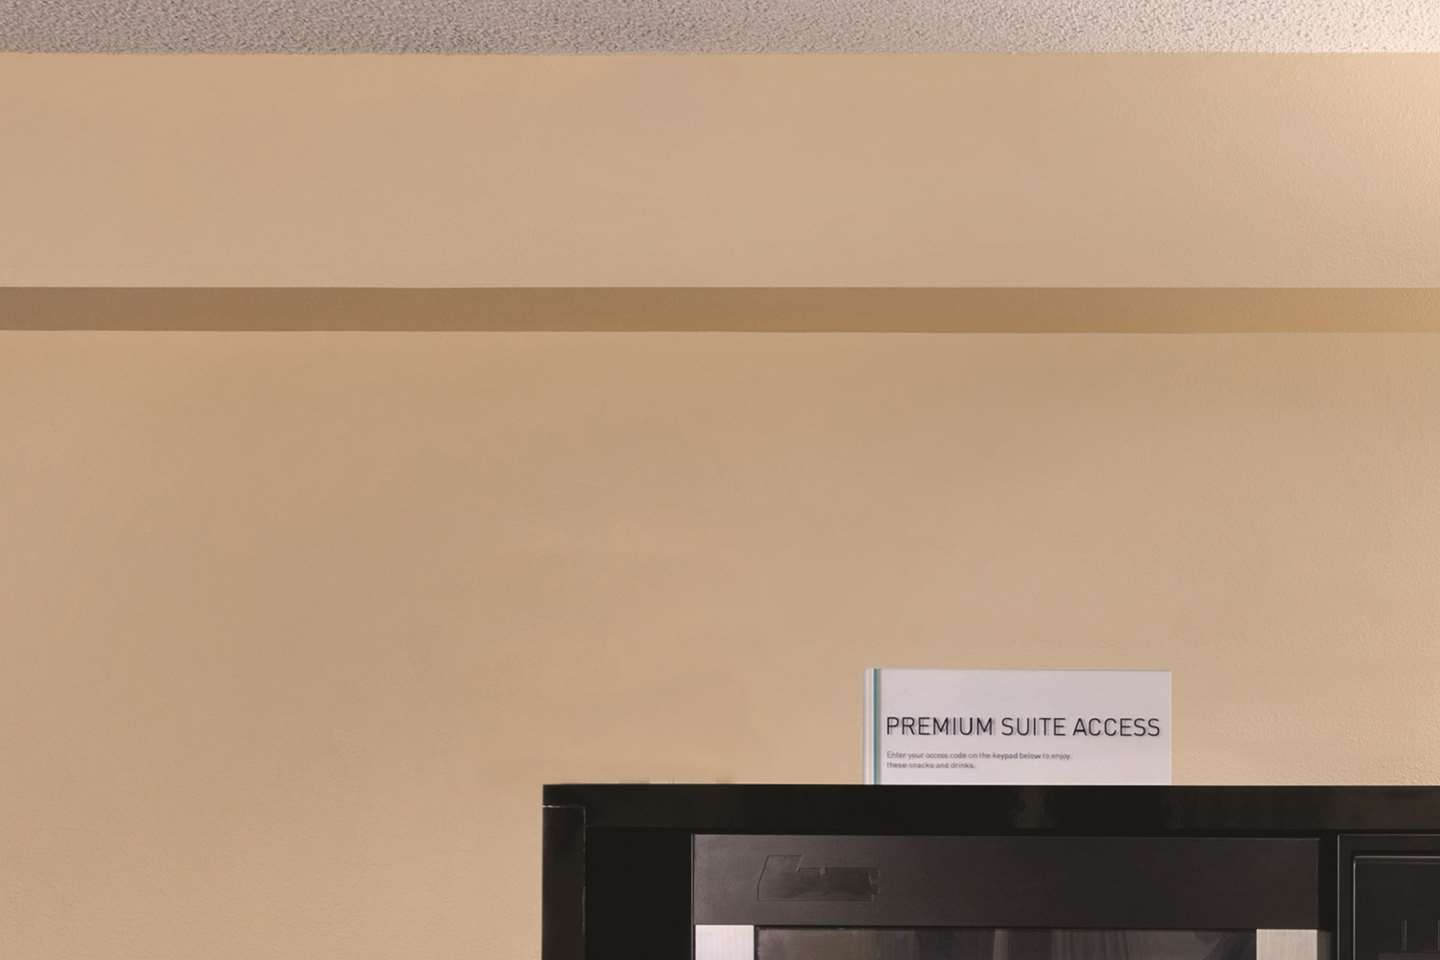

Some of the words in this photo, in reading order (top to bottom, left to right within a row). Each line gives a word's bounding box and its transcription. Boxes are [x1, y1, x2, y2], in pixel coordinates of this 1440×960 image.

[886, 716, 993, 736] PREMIUM
[1001, 717, 1066, 737] SUITE
[1072, 718, 1161, 737] ACCESS
[886, 750, 906, 759] Enter
[908, 752, 925, 760] your
[950, 751, 967, 759] code
[979, 751, 991, 759] the
[992, 751, 1019, 760] keypad
[1019, 752, 1041, 760] below
[886, 761, 907, 769] these
[909, 761, 934, 769] snacks
[935, 761, 949, 769] and
